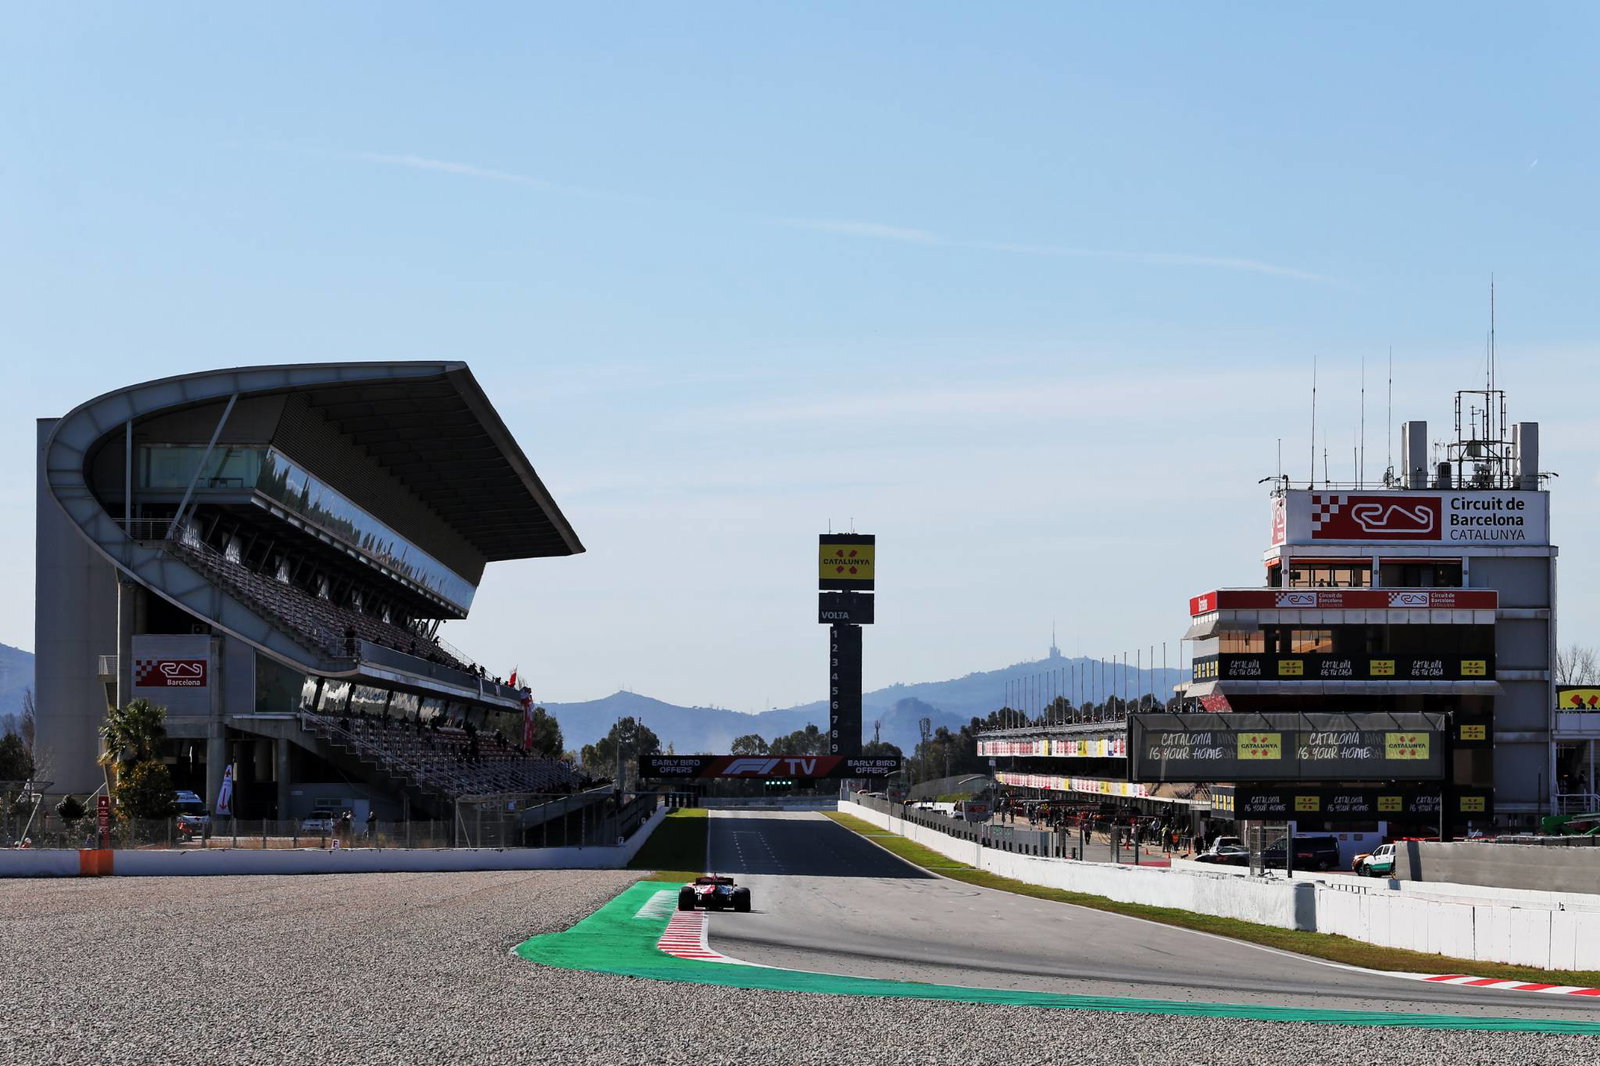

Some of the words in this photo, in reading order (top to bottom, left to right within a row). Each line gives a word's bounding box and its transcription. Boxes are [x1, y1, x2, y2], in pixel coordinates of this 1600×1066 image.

[1450, 496, 1503, 510] Circuit
[1506, 496, 1525, 510] de
[1450, 512, 1524, 526] Barcelona
[1450, 529, 1526, 541] CATALUNYA
[821, 611, 849, 619] VOLTA
[832, 630, 838, 638] 1
[832, 644, 838, 652] 2
[832, 658, 838, 667] 3
[832, 687, 838, 695] 5
[832, 701, 838, 709] 6
[832, 716, 838, 724] 7
[832, 730, 838, 738] 8
[1161, 732, 1211, 745] CATALONIA
[1309, 732, 1359, 745] CATALONIA
[832, 744, 838, 752] 9
[1149, 747, 1161, 760] IS
[1163, 746, 1190, 760] YOUR
[1192, 746, 1223, 759] HOME
[1298, 746, 1309, 760] IS
[1312, 746, 1338, 760] YOUR
[1340, 746, 1371, 759] HOME
[784, 758, 816, 775] TV
